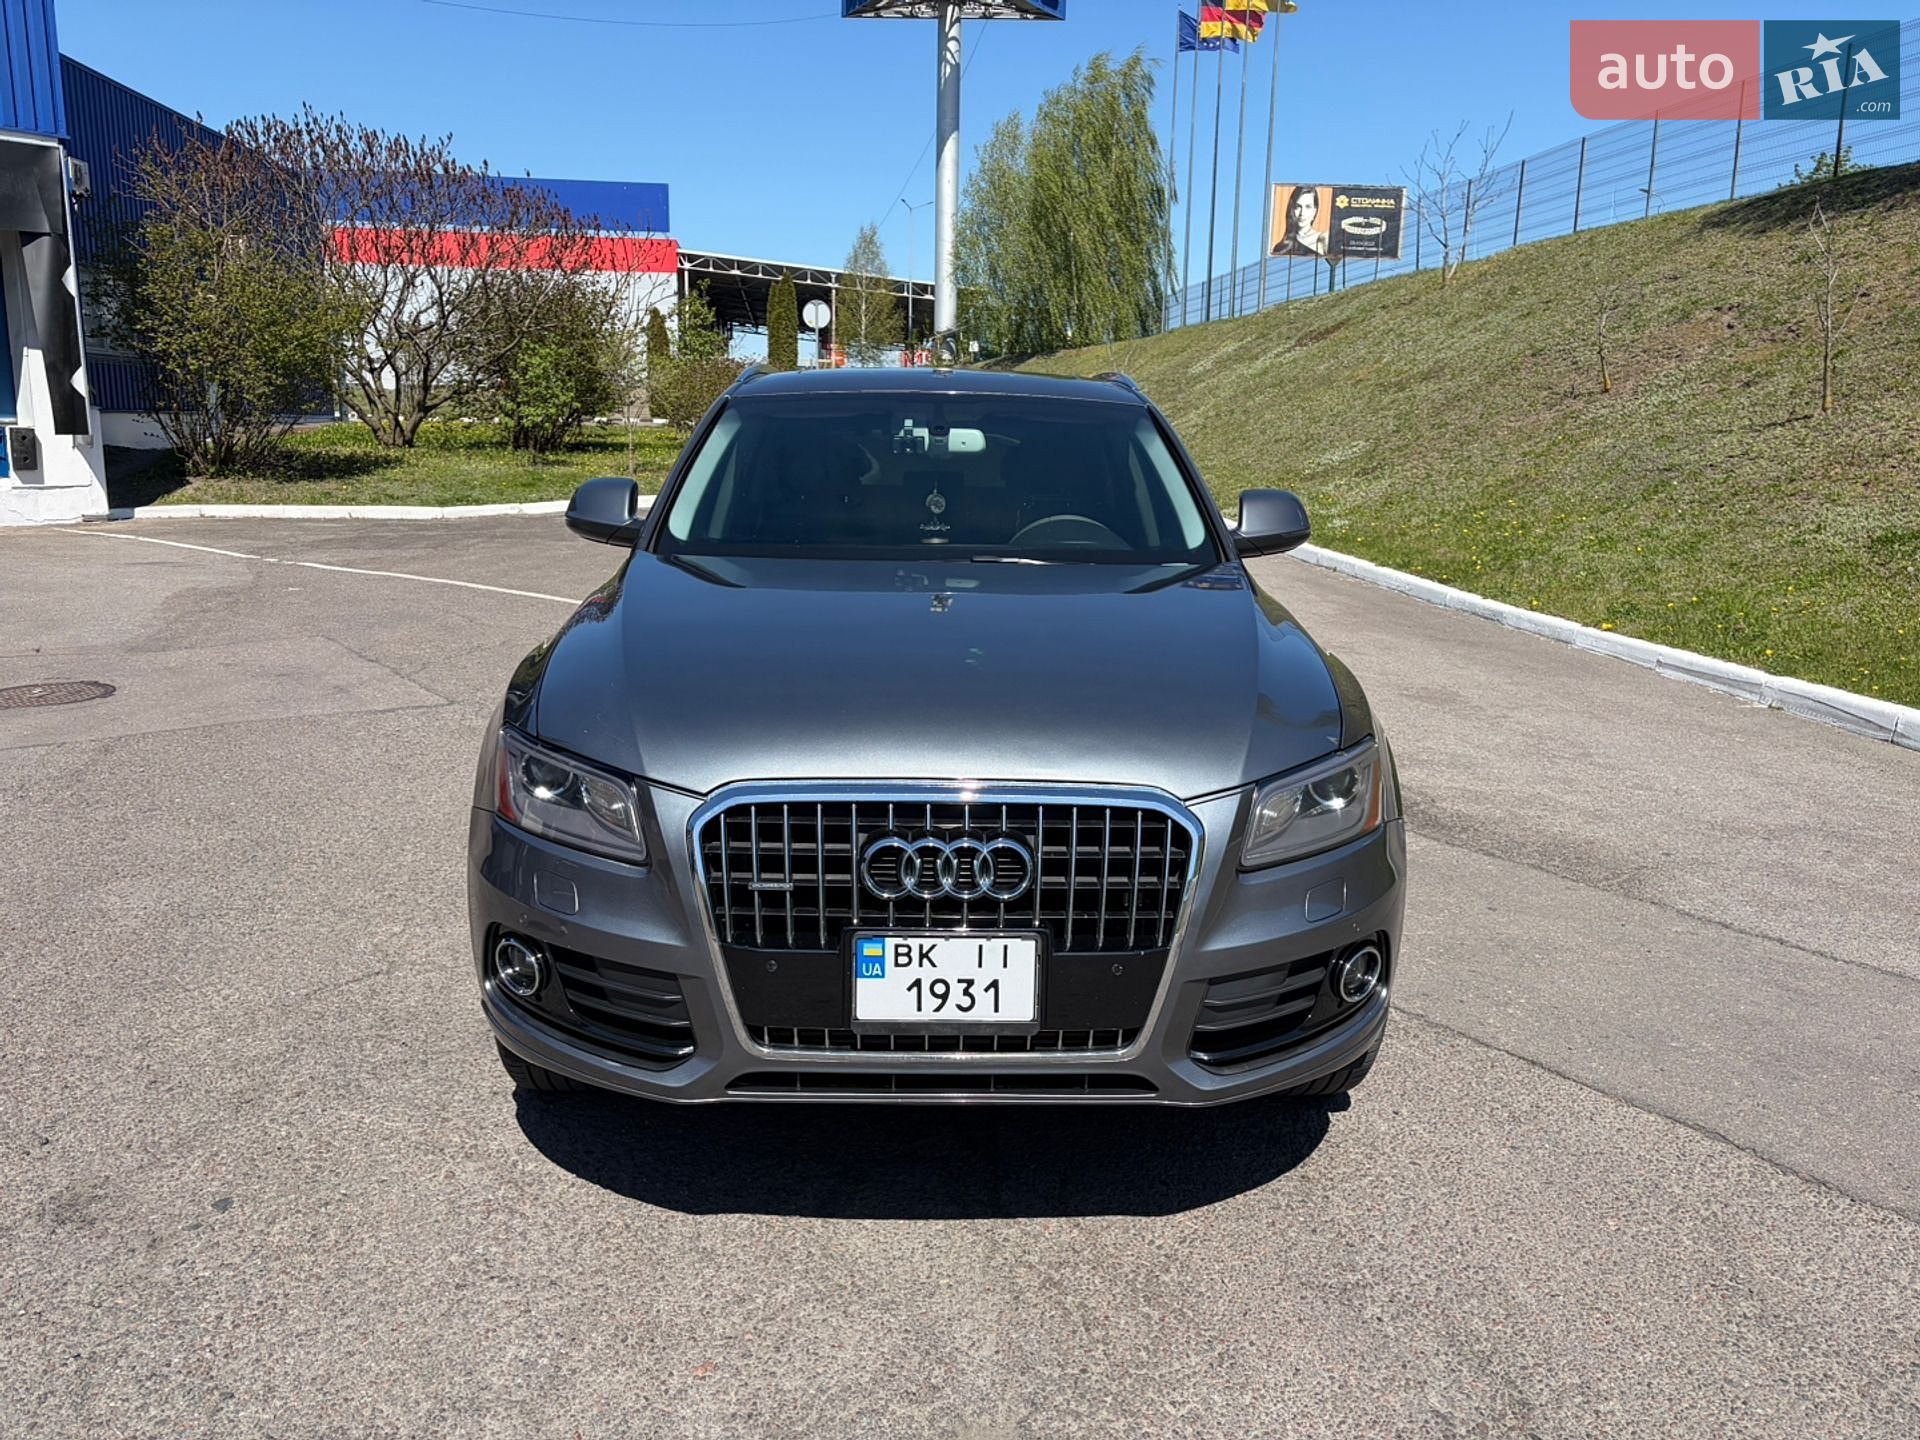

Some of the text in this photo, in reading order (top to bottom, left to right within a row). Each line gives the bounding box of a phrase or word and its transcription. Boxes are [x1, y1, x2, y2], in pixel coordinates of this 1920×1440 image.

[894, 943, 938, 968] BK
[862, 963, 883, 976] UA
[906, 977, 1000, 1013] 1931
